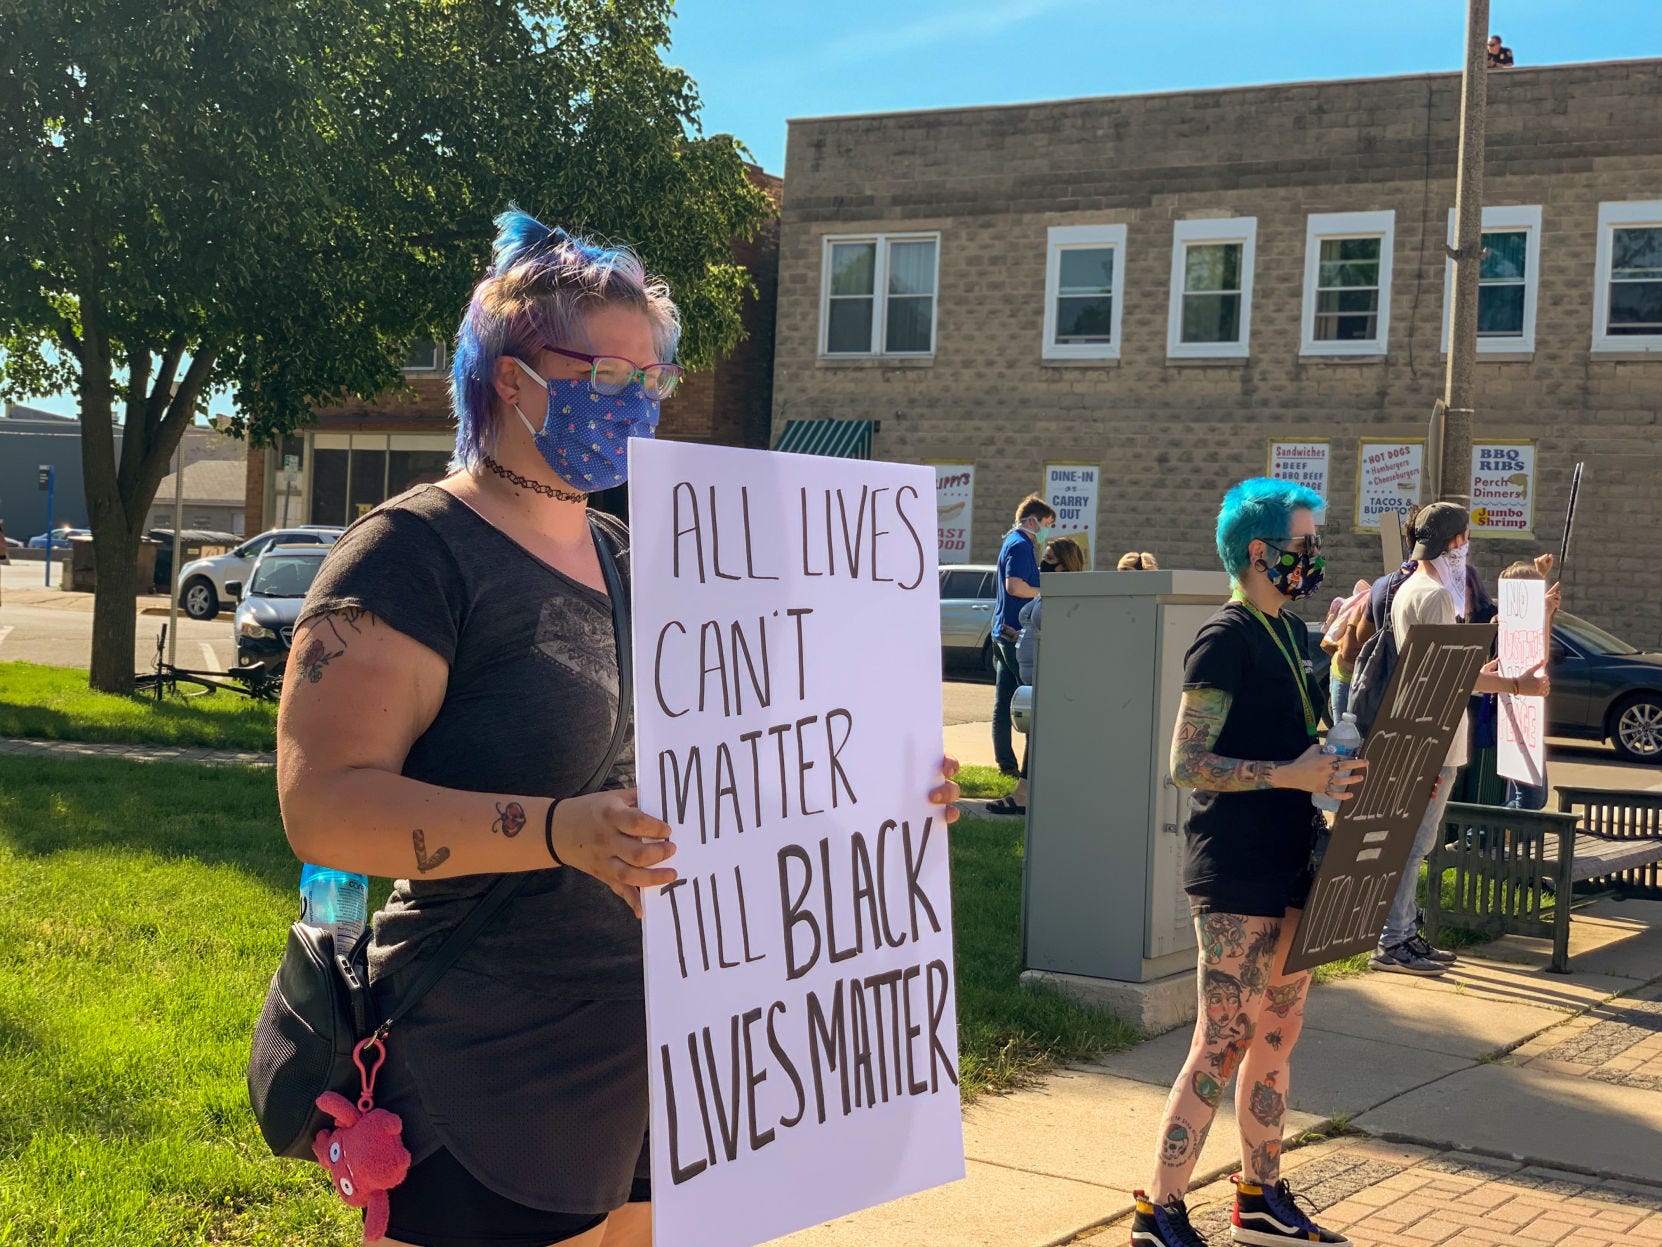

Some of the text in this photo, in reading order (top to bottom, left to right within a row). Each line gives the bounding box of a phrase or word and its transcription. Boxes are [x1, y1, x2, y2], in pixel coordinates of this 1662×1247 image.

[1276, 446, 1325, 457] Sandwiches
[1368, 446, 1410, 464] HOT DOGS
[1480, 448, 1519, 461] BBQ
[1371, 459, 1409, 475] Hamburgers
[1479, 460, 1525, 471] RIBS
[936, 472, 970, 490] IPPY'S
[1051, 470, 1094, 482] DINE-IN
[1282, 472, 1323, 480] BBQ BEEF
[1373, 468, 1419, 485] Cheeseburgers
[1474, 476, 1508, 487] Perch
[1473, 487, 1521, 498] Dinners
[1052, 495, 1089, 507] CARRY
[1370, 497, 1412, 506] TACOS &
[1059, 508, 1080, 520] OUT
[1478, 507, 1523, 517] Jumbo
[1478, 517, 1527, 529] Shrimp
[673, 481, 924, 590] ALL LIVES
[938, 528, 966, 539] AST
[938, 540, 966, 550] OOD
[1506, 581, 1529, 620] NO
[654, 608, 814, 717] CAN'T
[1390, 641, 1483, 731] WHITE
[659, 708, 858, 844] MATTER
[1344, 730, 1439, 819] SILENCE
[660, 816, 942, 981] TILL BLACK
[1301, 871, 1397, 955] VIOLENCE
[660, 959, 959, 1185] LIVES MATTER
